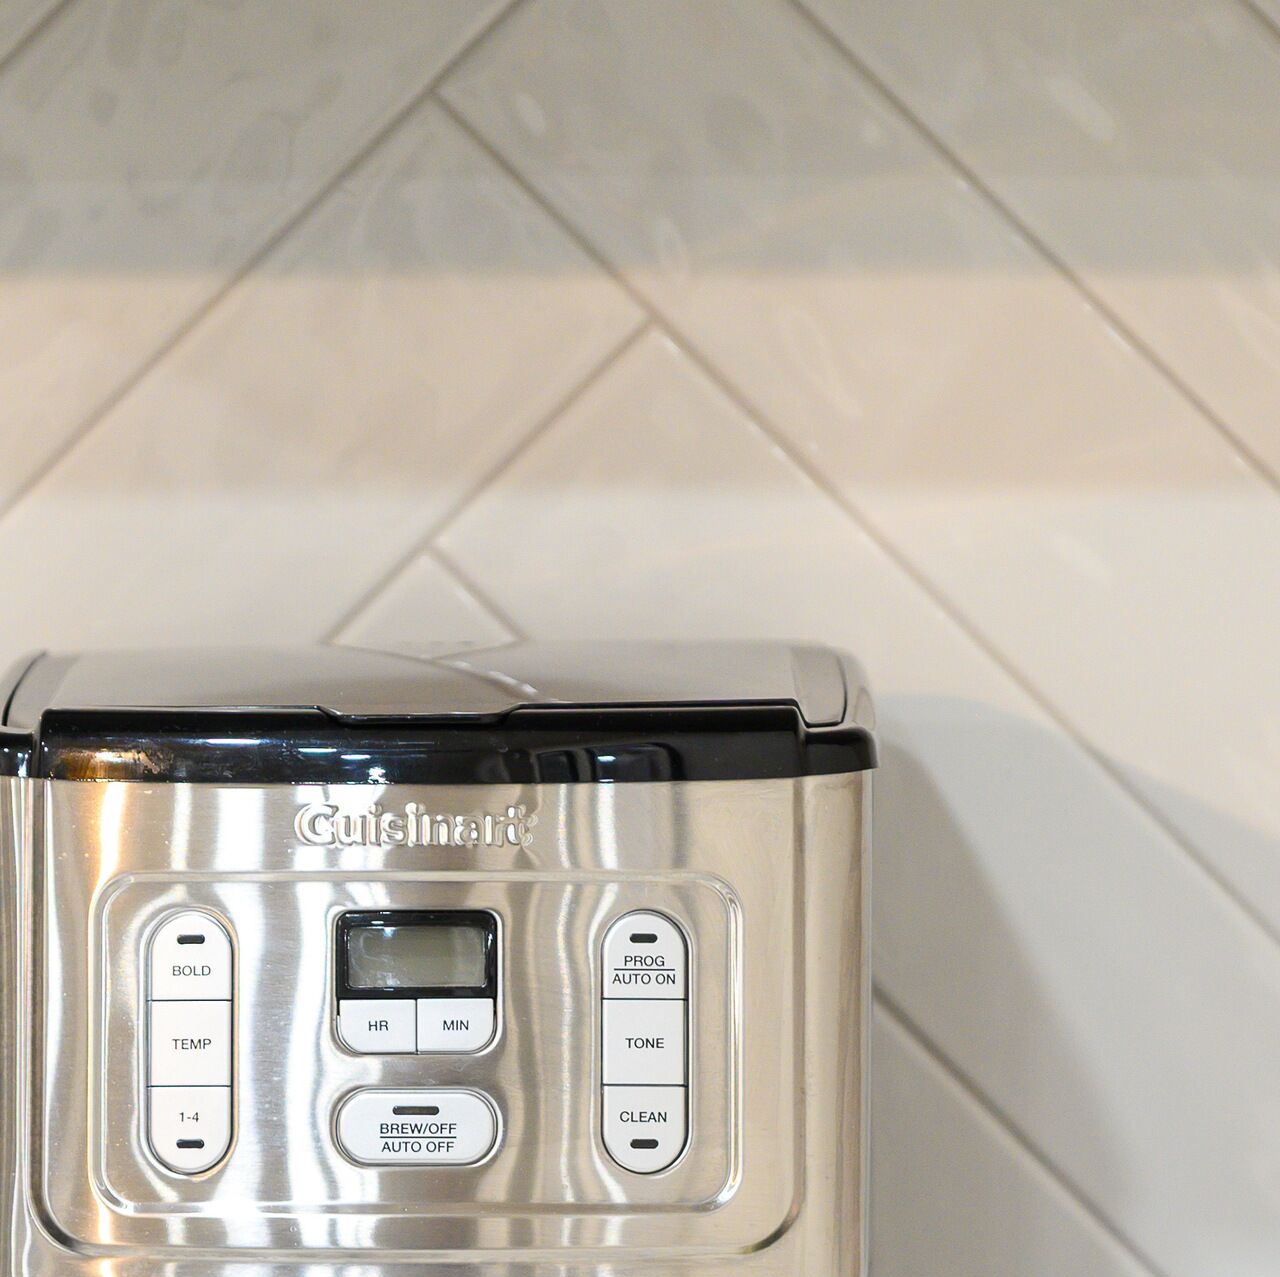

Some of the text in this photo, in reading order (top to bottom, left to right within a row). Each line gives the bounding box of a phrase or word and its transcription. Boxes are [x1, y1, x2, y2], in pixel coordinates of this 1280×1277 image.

[294, 802, 534, 846] Cuisinart
[624, 955, 665, 967] PROG
[172, 965, 212, 977] BOLD
[612, 973, 676, 985] AUTO ON
[368, 1020, 389, 1031] HR
[443, 1020, 469, 1031] MIN
[172, 1038, 212, 1050] TEMP
[625, 1037, 665, 1049] TONE
[179, 1112, 200, 1123] 1-4
[619, 1111, 667, 1123] CLEAN
[379, 1123, 457, 1135] BREW/OFF
[381, 1141, 455, 1153] AUTO OFF
